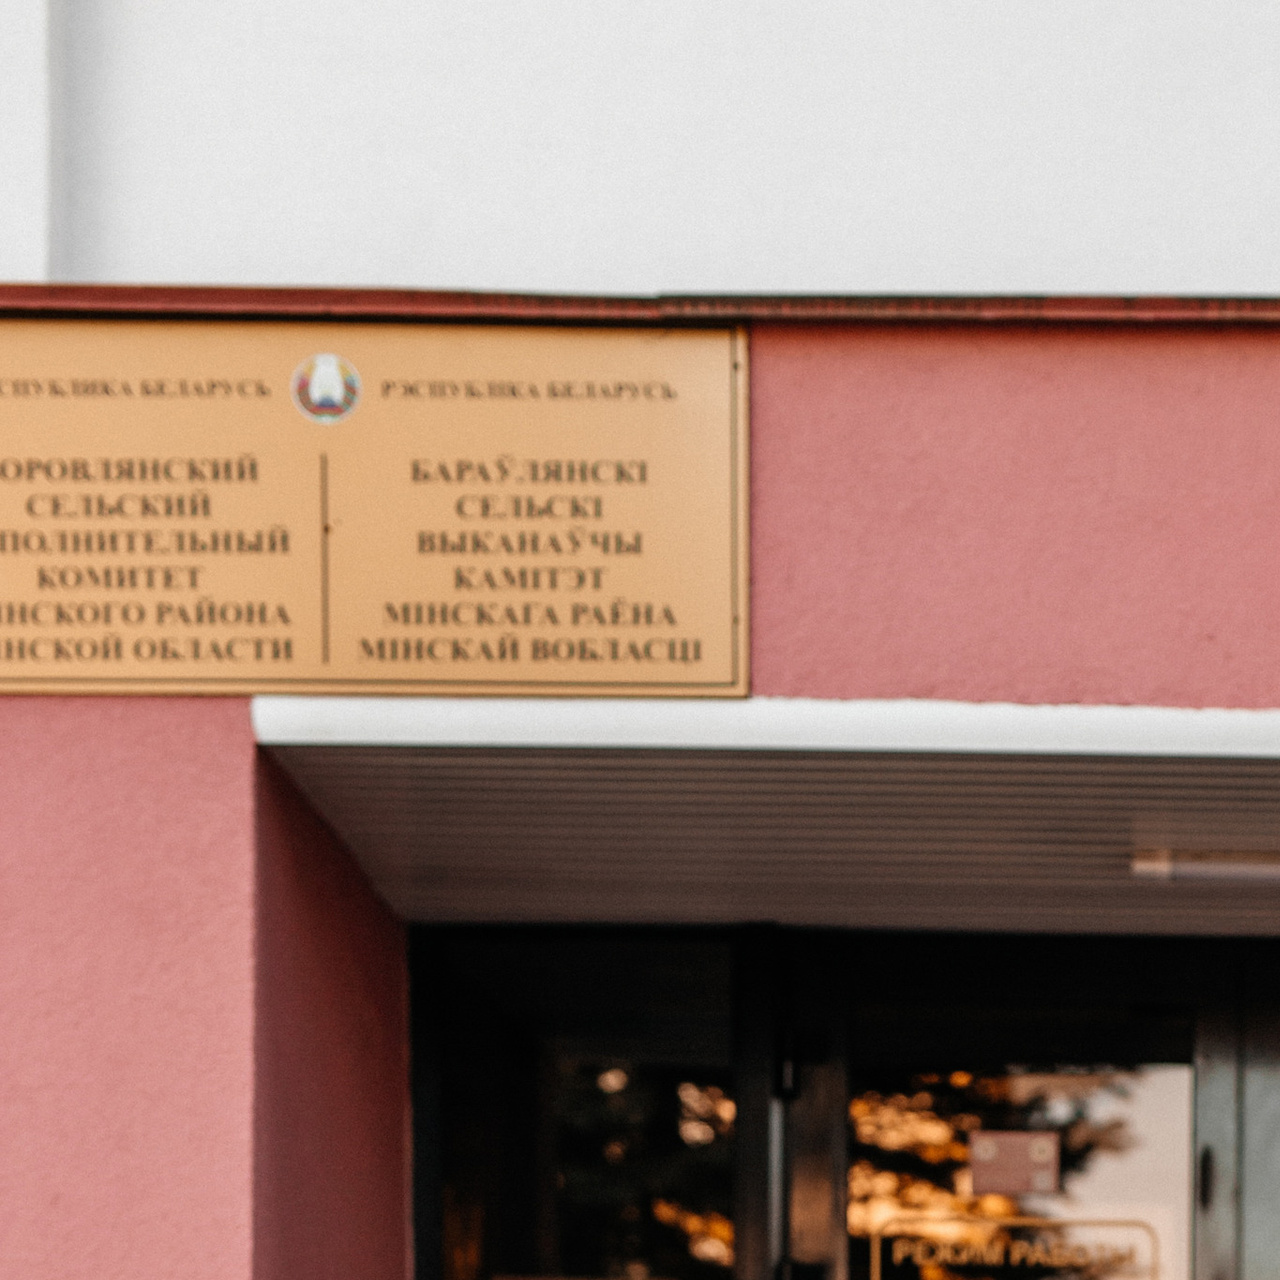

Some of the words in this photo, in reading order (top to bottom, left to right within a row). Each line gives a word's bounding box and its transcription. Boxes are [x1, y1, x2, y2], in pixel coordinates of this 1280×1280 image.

[0, 454, 260, 484] ОРОВЛЯНСКИЙ
[411, 454, 649, 487] БАРАЎЛЯНСКІ
[26, 491, 212, 519] СЕЛЬСКИЙ
[456, 494, 604, 521] СЕЛЬСКІ
[0, 526, 292, 556] ПОЛНИТЕЛЬНЫЙ
[417, 526, 644, 557] ВЫКАНАЎЧЫ
[38, 567, 205, 591] КОМИТЕТ
[455, 567, 608, 592] КАМІТЭТ
[0, 603, 147, 627] НСКОГО
[157, 598, 292, 628] РАЙОНА
[384, 603, 560, 627] МІНСКАГА
[572, 599, 679, 628] РАЁНА
[3, 635, 124, 661] НСКОЙ
[134, 638, 295, 664] ОБЛАСТИ
[360, 635, 521, 663] МІНСКАЙ
[532, 639, 703, 666] ВОБЛАСЦІ
